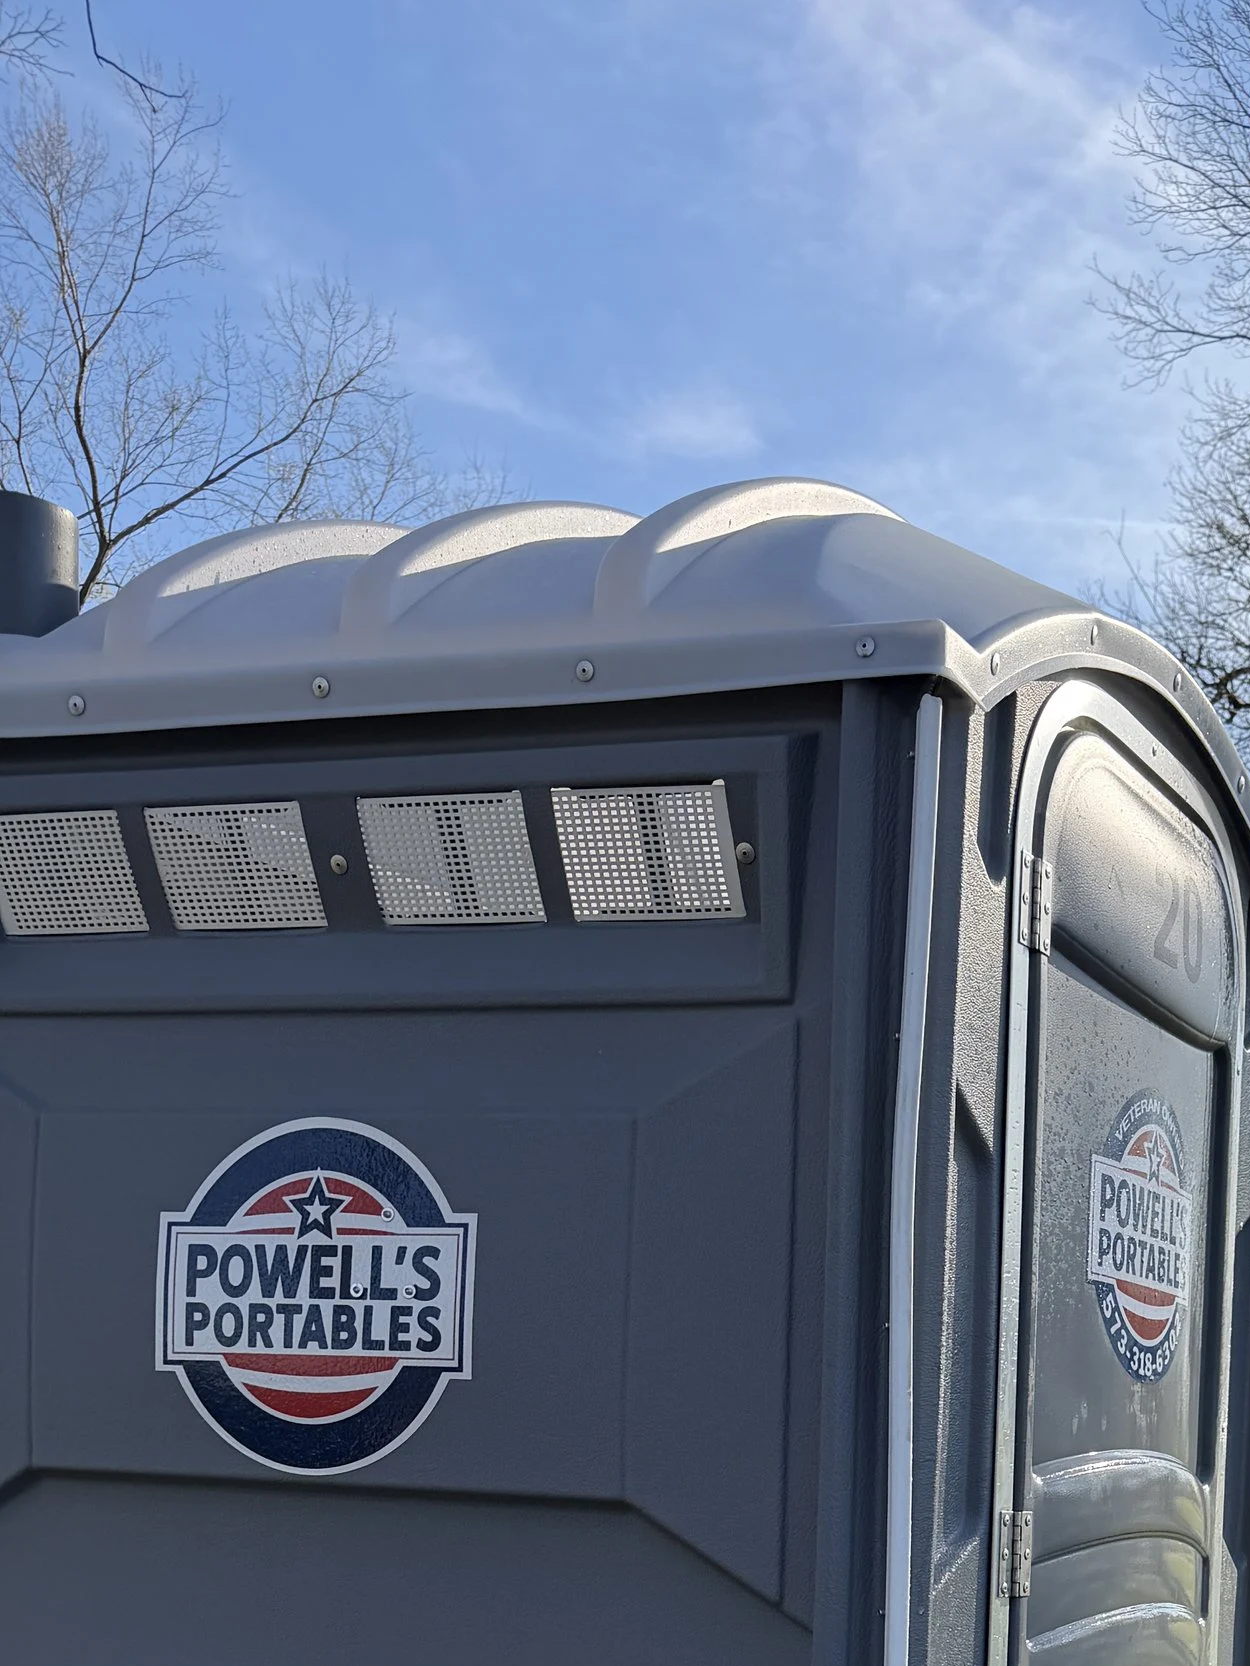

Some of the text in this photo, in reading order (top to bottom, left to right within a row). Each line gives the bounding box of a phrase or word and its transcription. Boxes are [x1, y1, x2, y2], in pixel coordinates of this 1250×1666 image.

[1114, 1098, 1161, 1141] VETERAN
[1099, 1172, 1188, 1250] POWELL'S
[184, 1243, 442, 1302] POWELL'S
[184, 1302, 442, 1353] PORTABLES
